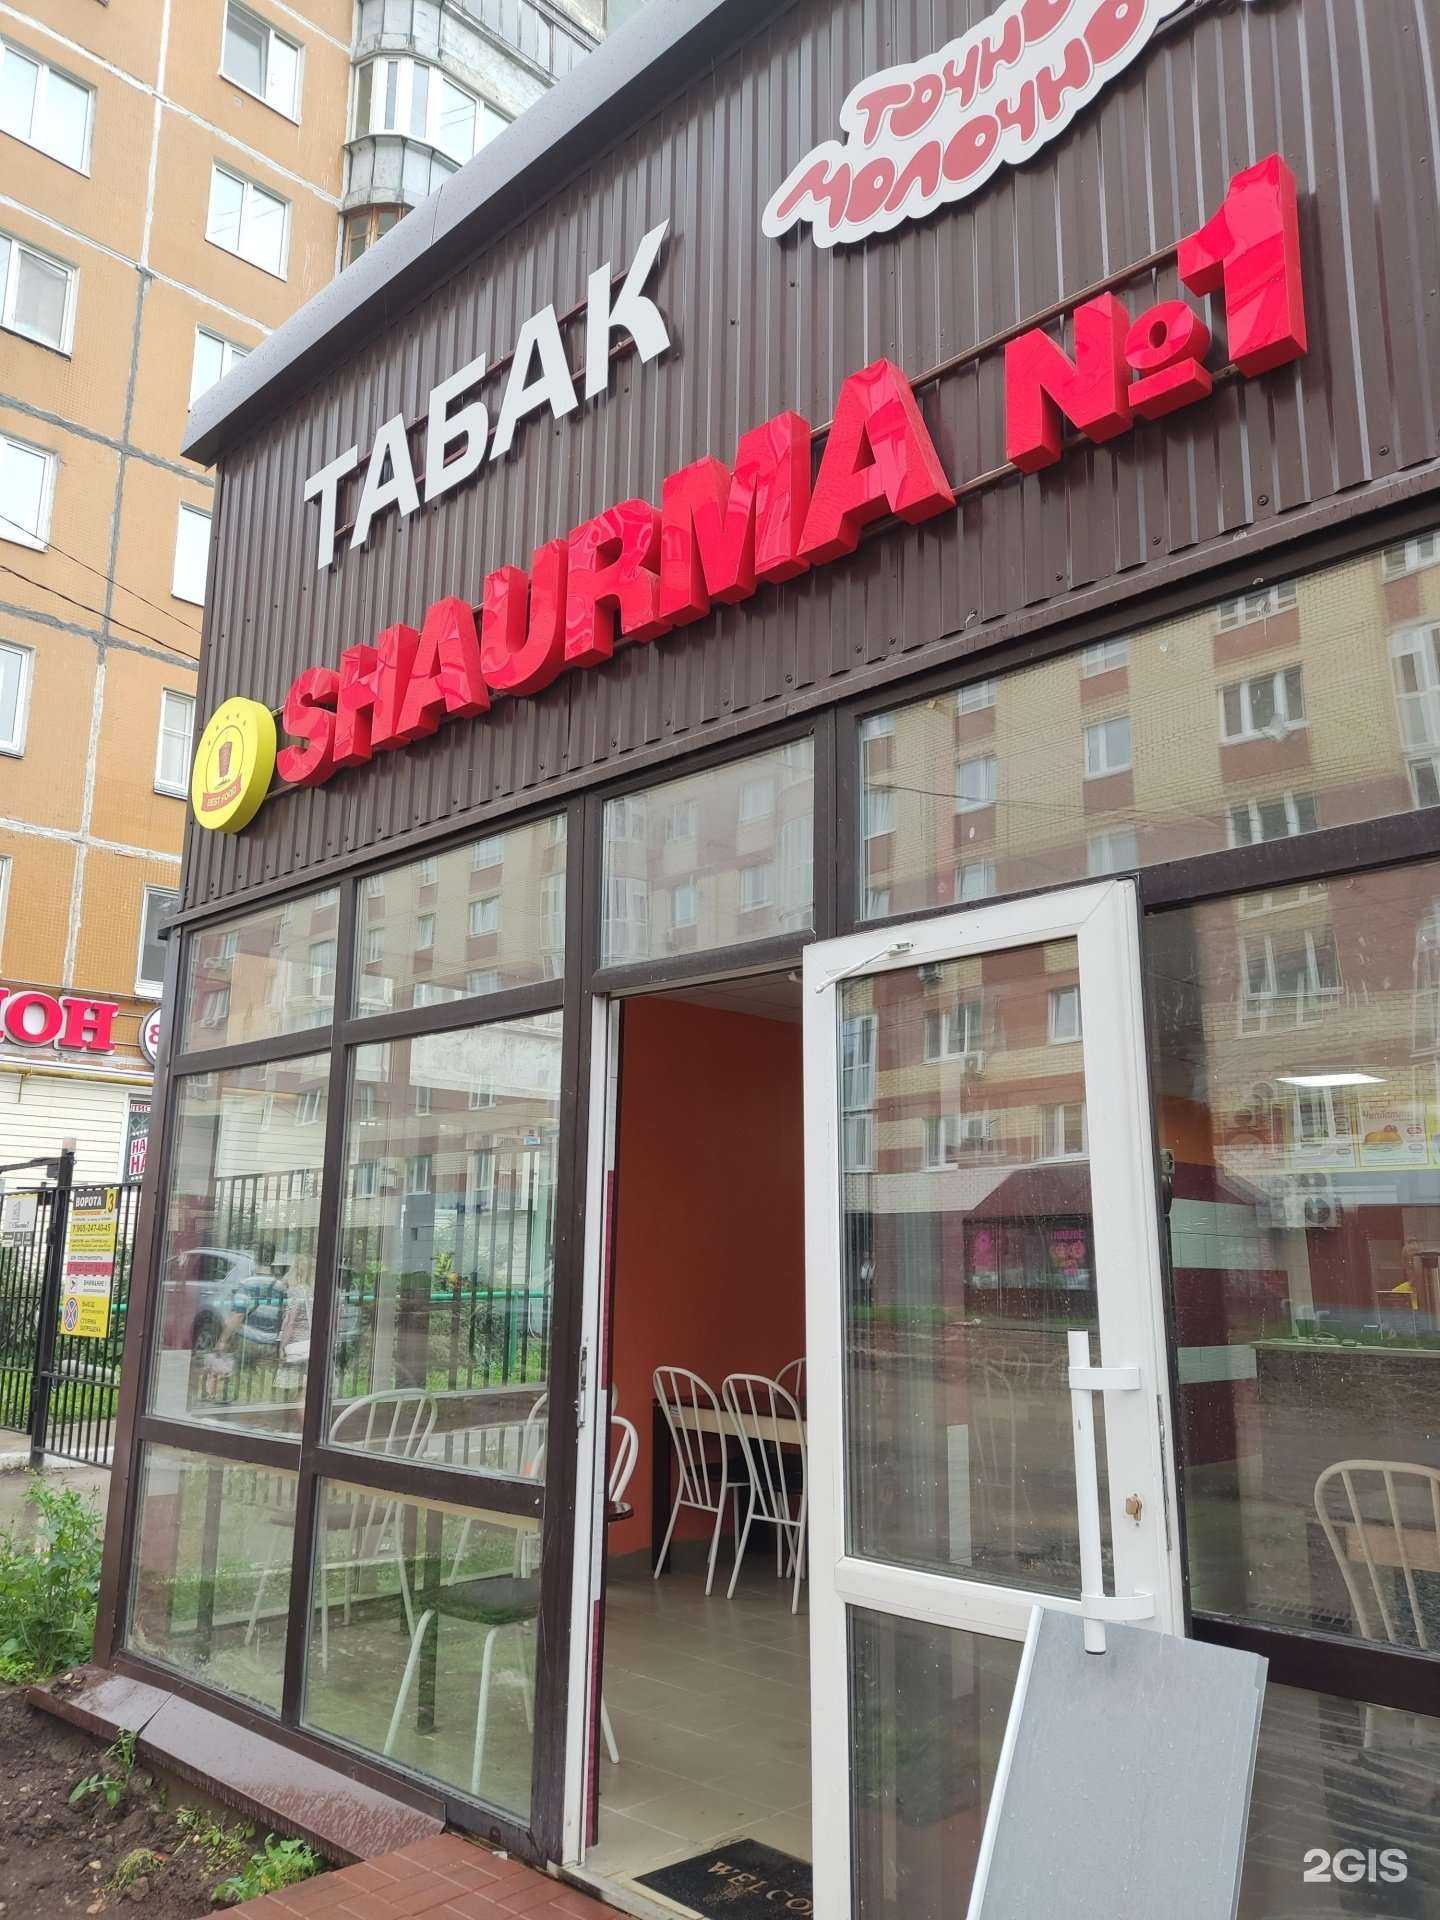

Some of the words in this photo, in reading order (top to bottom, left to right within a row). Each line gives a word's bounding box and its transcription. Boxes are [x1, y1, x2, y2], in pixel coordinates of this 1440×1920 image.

[304, 219, 671, 570] ТАБАК
[277, 358, 957, 787] SHAURMA
[75, 1196, 102, 1207] ВОРОТА
[707, 1861, 813, 1916] WELCO
